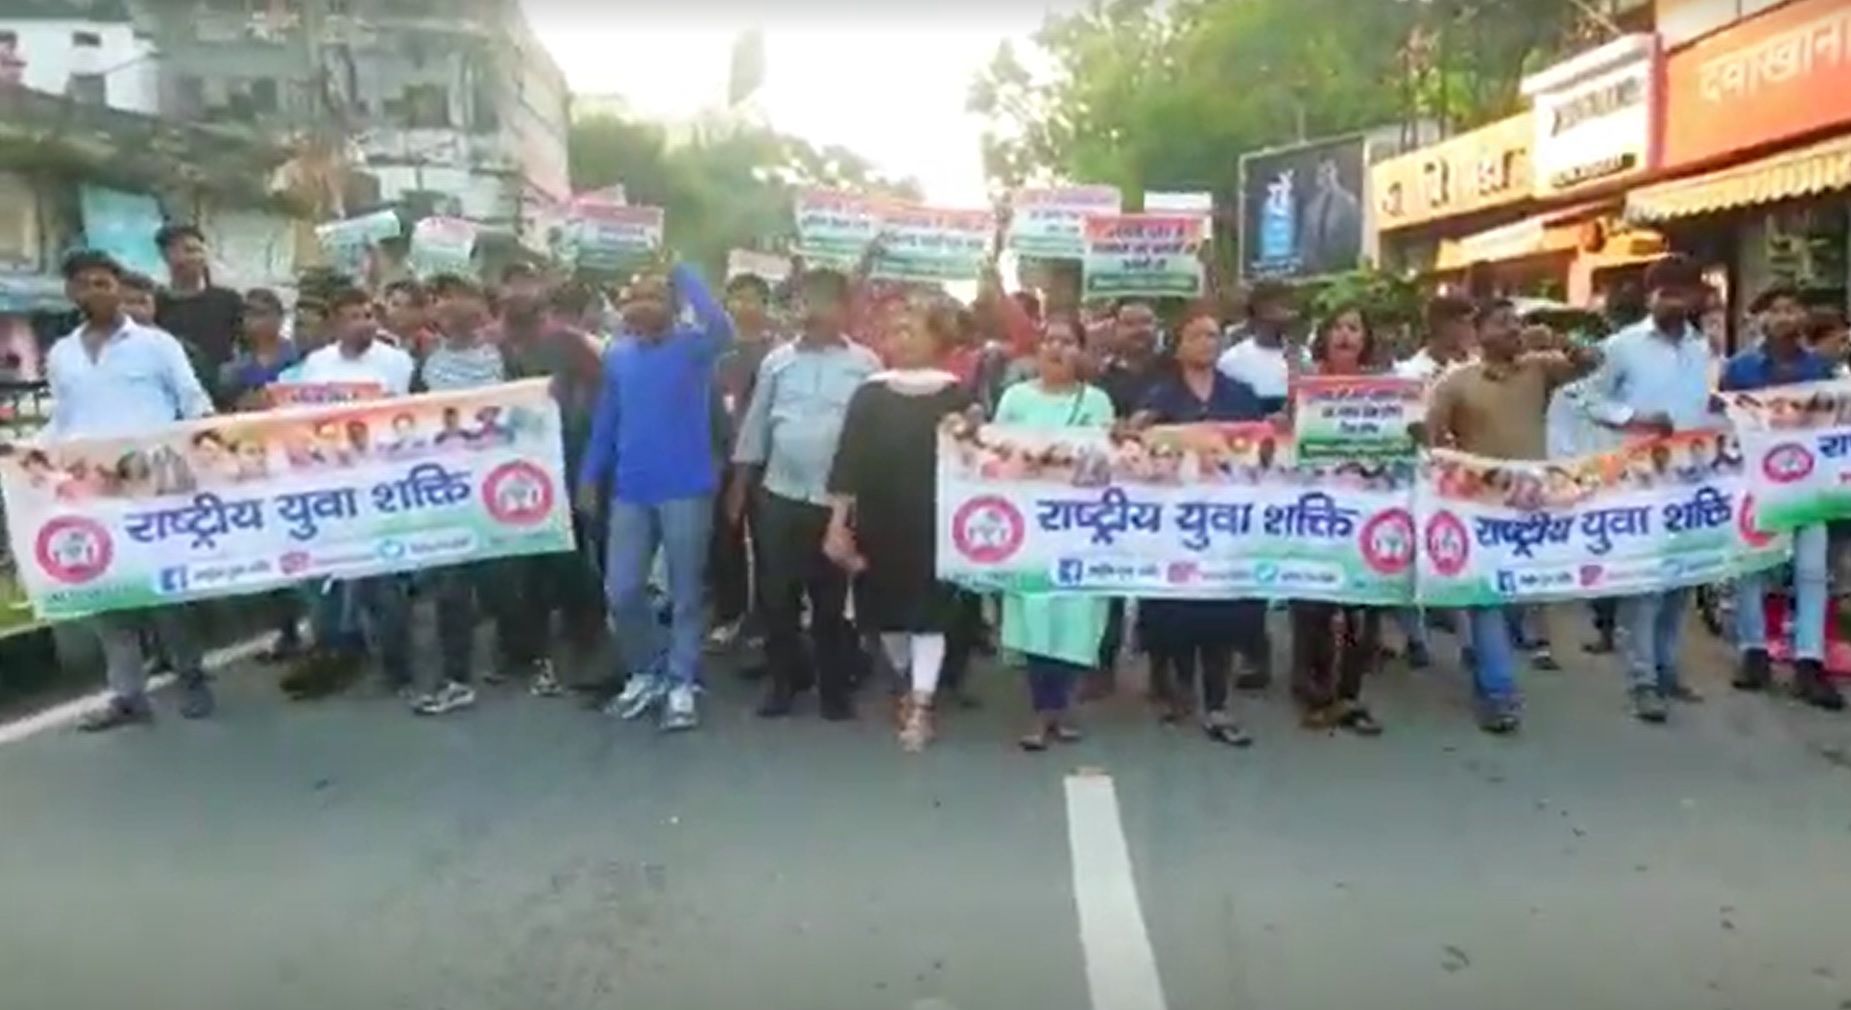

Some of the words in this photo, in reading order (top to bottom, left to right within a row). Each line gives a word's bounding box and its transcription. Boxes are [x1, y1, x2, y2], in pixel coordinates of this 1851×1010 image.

[125, 492, 265, 549] राष्ट्रीय
[275, 487, 357, 541] युवा
[371, 463, 473, 513] शक्ति
[1036, 486, 1162, 545] राष्ट्रीय
[1175, 501, 1254, 551] युवा
[1263, 491, 1359, 538] शक्ति
[1474, 511, 1575, 557] राष्ट्रीय
[1581, 504, 1649, 554] युवा
[1661, 487, 1734, 534] शक्ति
